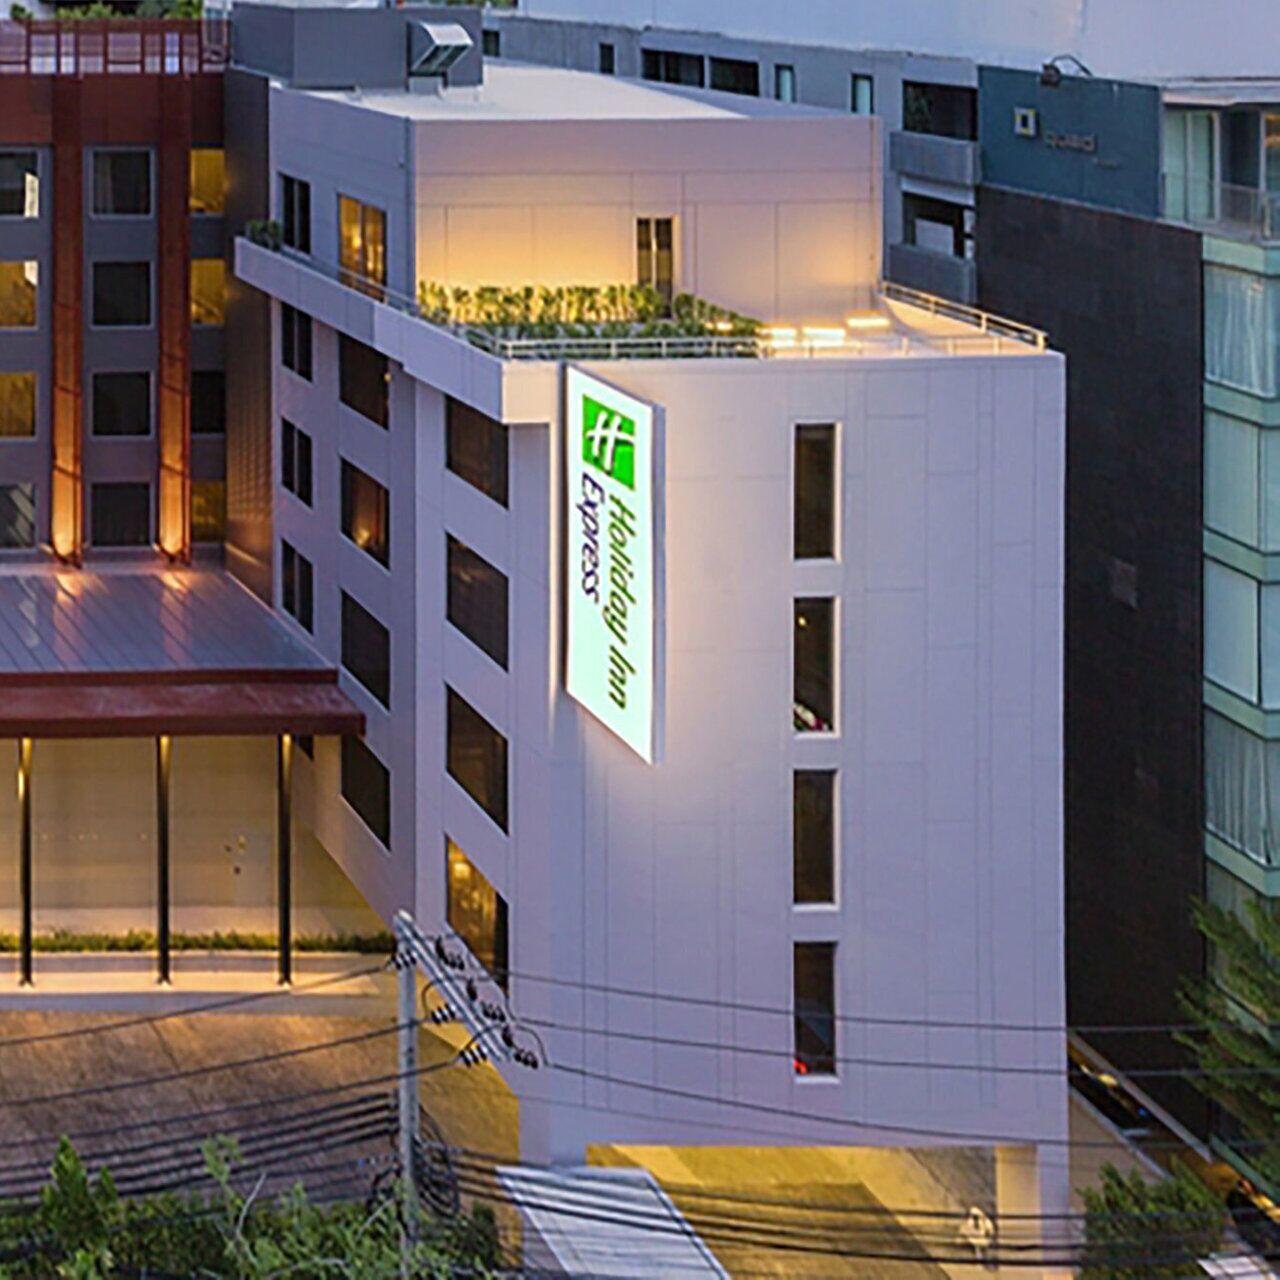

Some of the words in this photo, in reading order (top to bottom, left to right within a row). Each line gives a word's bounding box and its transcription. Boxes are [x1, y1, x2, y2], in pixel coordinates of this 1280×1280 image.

[576, 472, 605, 605] Express
[602, 493, 636, 646] Holiday
[607, 644, 637, 710] Inn
